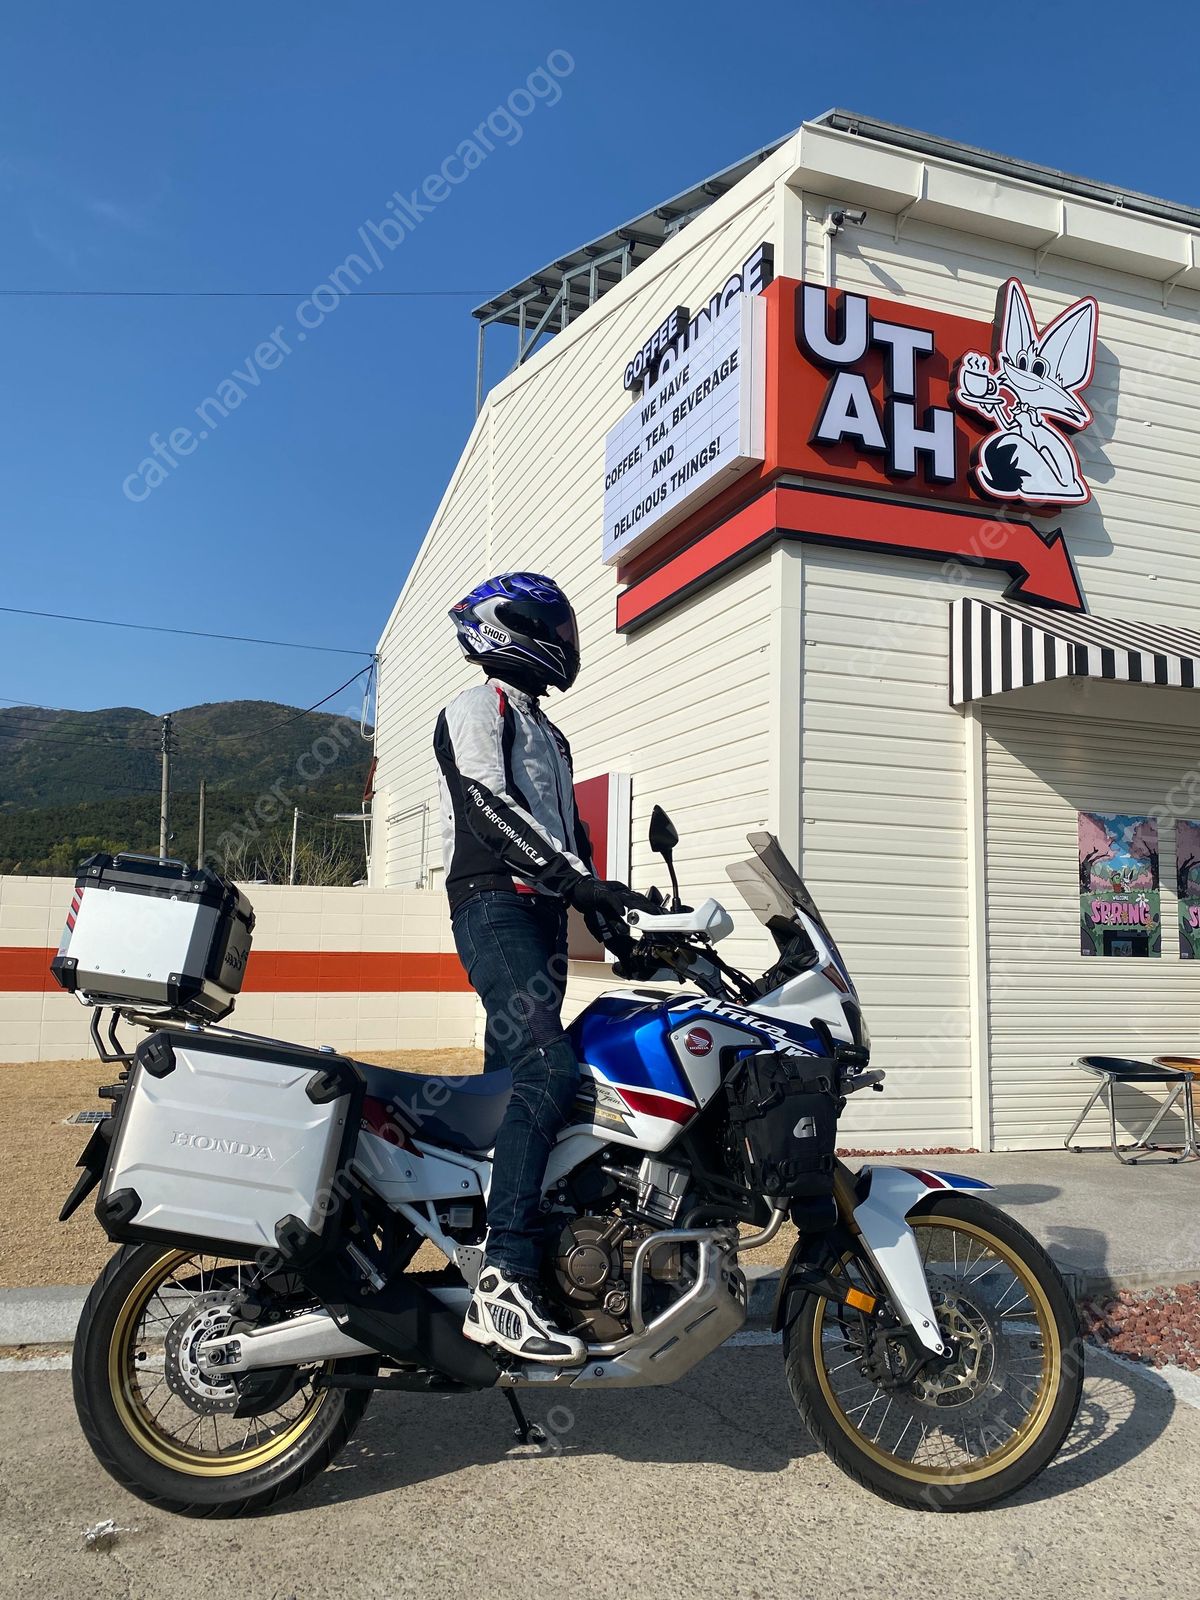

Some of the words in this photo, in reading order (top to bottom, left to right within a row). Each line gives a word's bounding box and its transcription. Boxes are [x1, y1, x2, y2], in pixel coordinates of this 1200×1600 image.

[624, 306, 681, 390] COFFEE
[641, 402, 657, 427] WE
[660, 364, 690, 409] HAVE
[605, 444, 643, 491] COFFEE,
[645, 421, 669, 451] TEA,
[672, 350, 739, 428] BEVERAGE
[651, 444, 675, 479] AND
[613, 483, 668, 541] DELICIOUS
[670, 436, 721, 493] THINGS!
[482, 625, 507, 643] SHOEI
[482, 805, 538, 860] PERFORMANCE
[1091, 901, 1150, 926] SPRING
[668, 998, 788, 1037] Africa
[170, 1130, 276, 1161] HONDA
